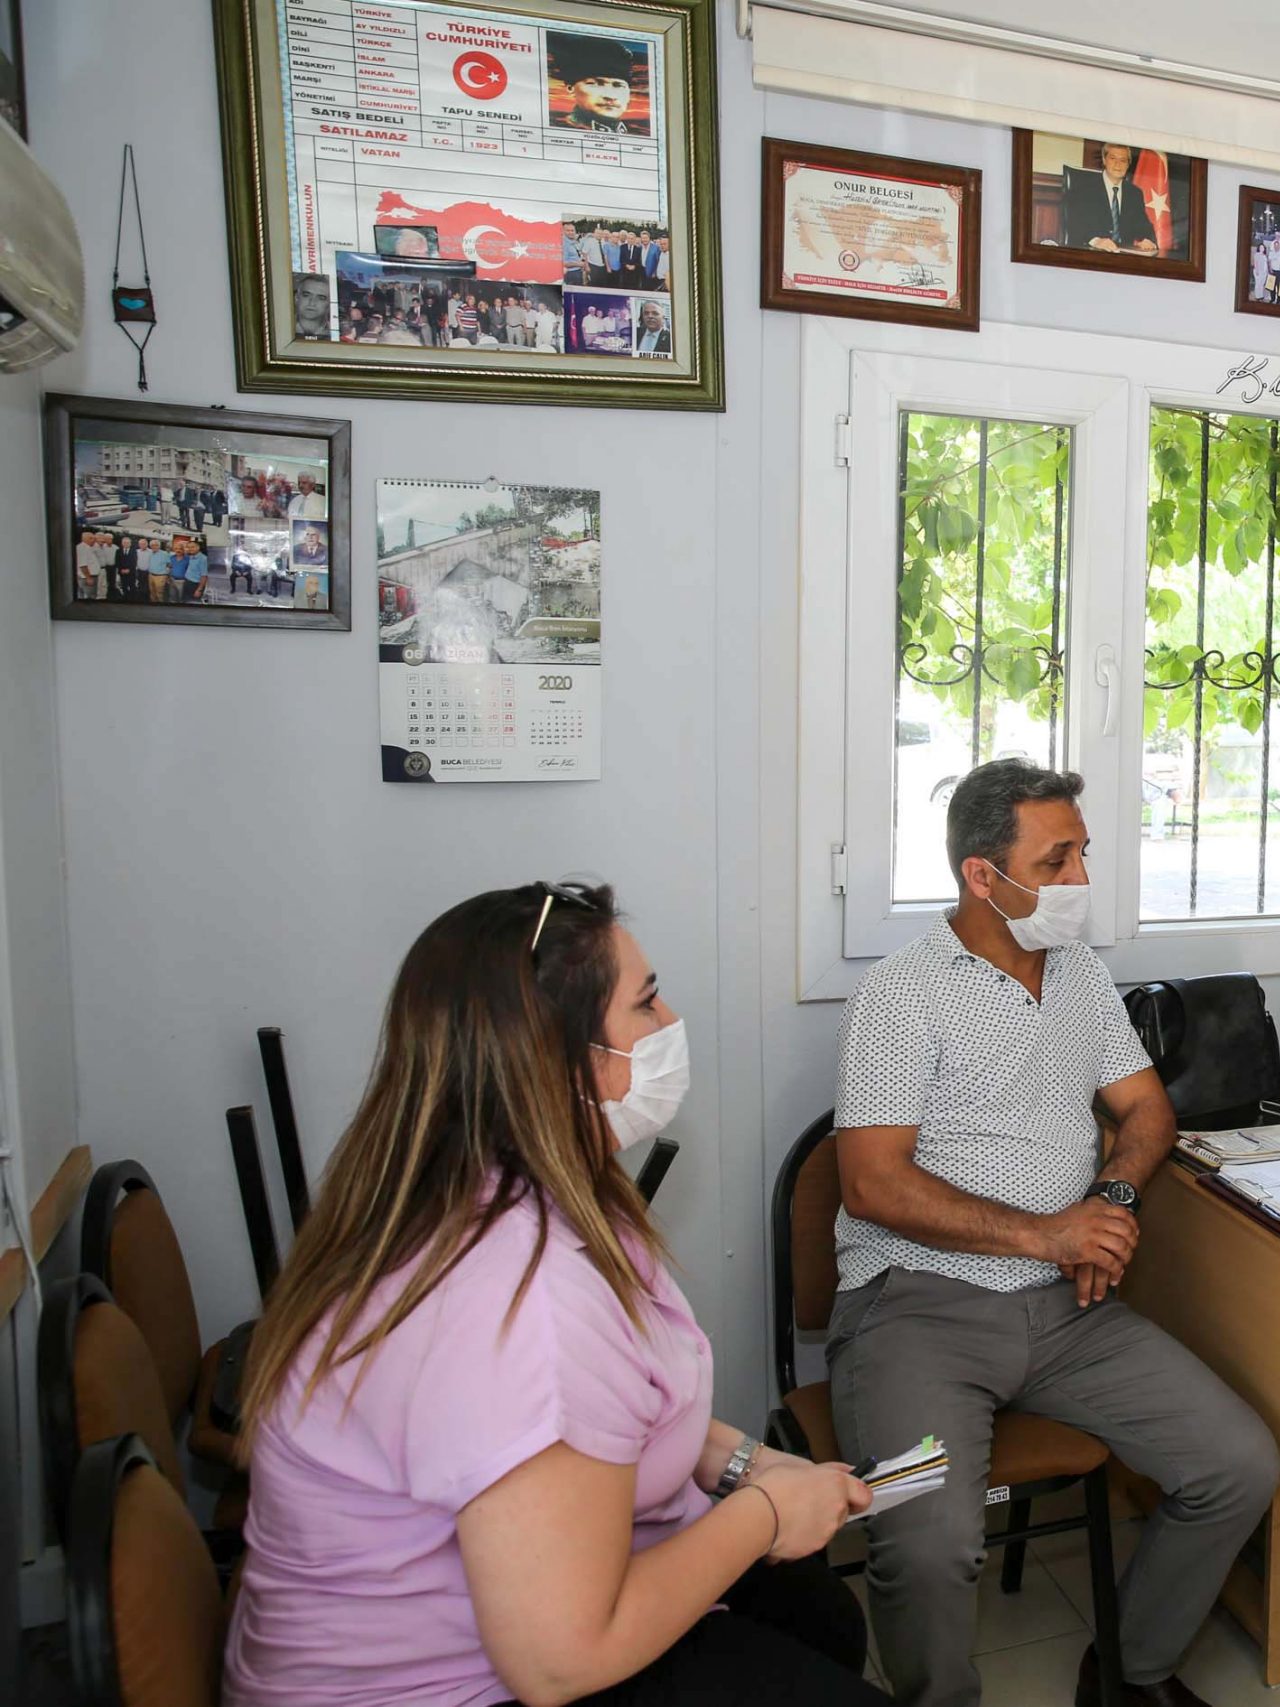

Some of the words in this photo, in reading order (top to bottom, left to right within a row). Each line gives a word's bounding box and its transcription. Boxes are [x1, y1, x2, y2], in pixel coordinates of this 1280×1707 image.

[446, 22, 512, 39] TÜRKİYE
[425, 32, 532, 53] CUMHURİYETİ
[358, 69, 395, 78] ANKARA
[311, 107, 351, 120] SATIŞ
[356, 112, 404, 125] BEDELİ
[441, 106, 473, 116] TAPU
[477, 110, 522, 121] SENEDİ
[320, 124, 408, 142] SATILAMAZ
[361, 147, 401, 158] VATAN
[470, 142, 498, 150] 1923
[834, 181, 867, 193] ONUR
[870, 185, 914, 200] BELGESİ
[304, 184, 317, 275] AYRİMENKULUN
[404, 649, 424, 659] 06
[538, 675, 573, 691] 2020
